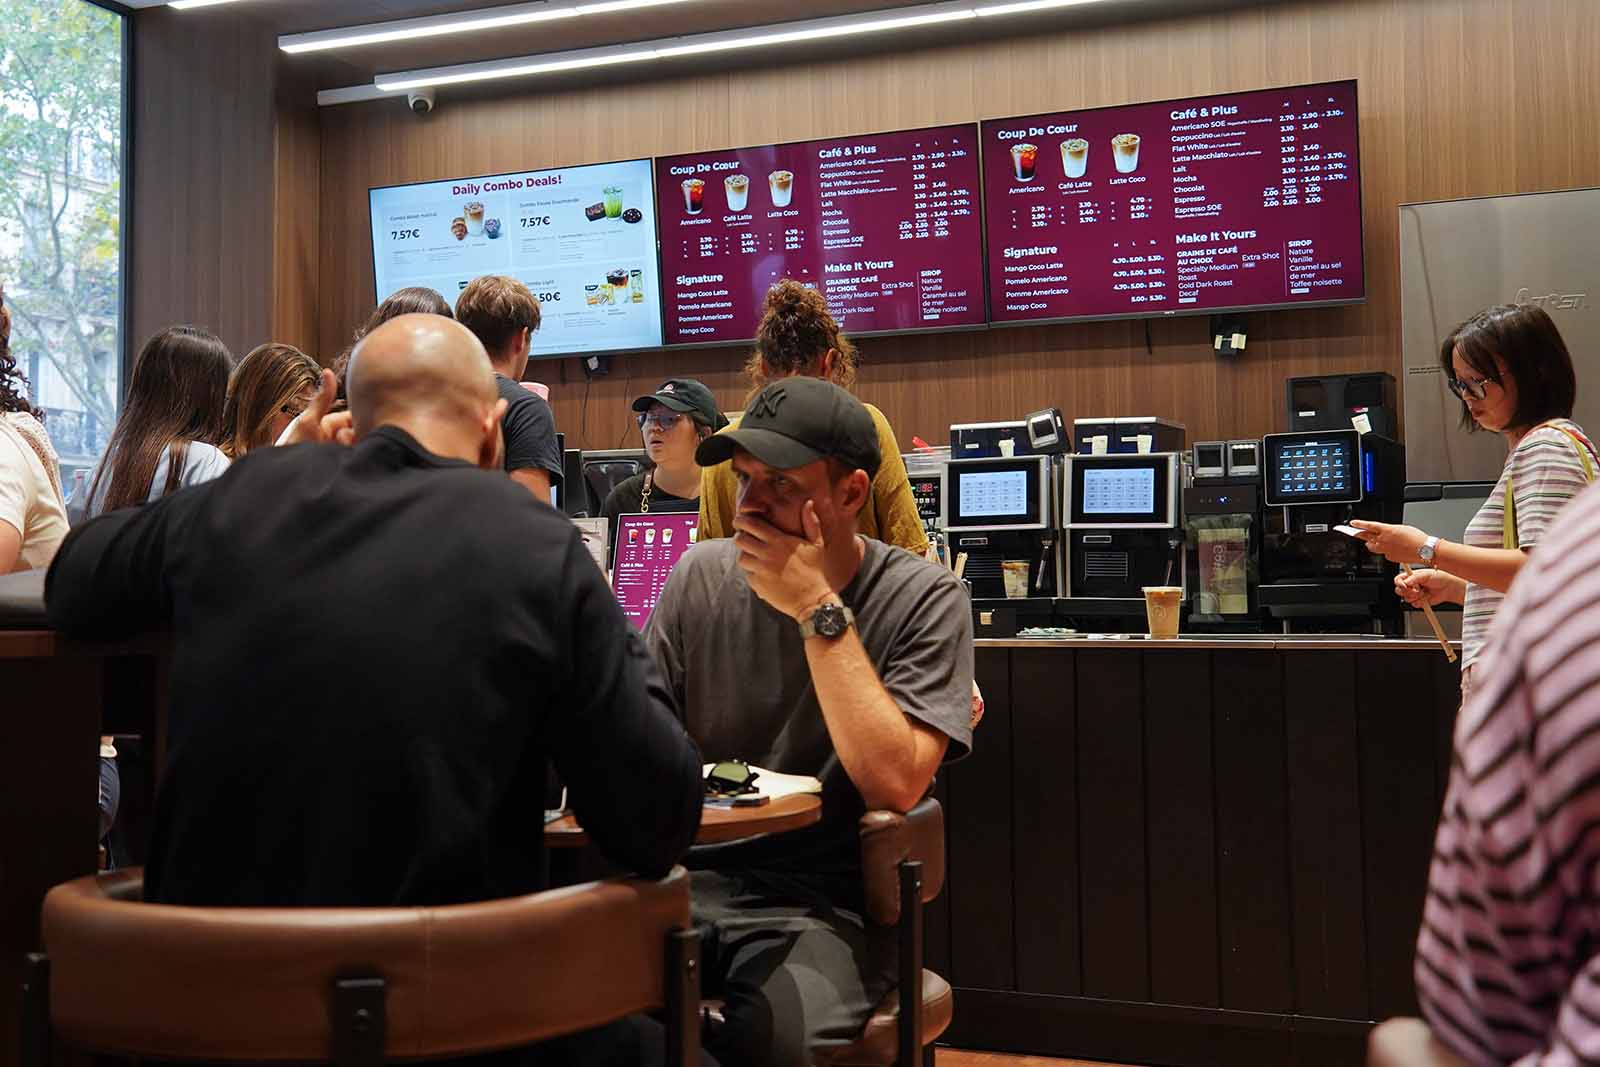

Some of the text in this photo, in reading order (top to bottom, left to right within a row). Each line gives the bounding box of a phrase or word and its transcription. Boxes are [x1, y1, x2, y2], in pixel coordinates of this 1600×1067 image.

[1171, 105, 1238, 120] Café & Plus
[998, 124, 1078, 140] Coup De Cœur
[1171, 123, 1209, 132] Americano
[1172, 132, 1213, 142] Cappuccino
[819, 145, 876, 158] Café & Plus
[1192, 152, 1228, 161] Macchiato
[670, 161, 740, 175] Coup De Cœur
[820, 161, 852, 169] Americano
[820, 170, 856, 179] Cappuccino
[1174, 175, 1197, 183] Mocha
[453, 175, 562, 195] Daily Combo Deals!
[1058, 182, 1074, 190] Café
[1174, 185, 1205, 193] Chocolat
[838, 188, 868, 196] Macchiato
[1009, 186, 1044, 194] Americano
[1175, 196, 1205, 204] Espresso
[1175, 206, 1205, 214] Espresso
[1176, 230, 1256, 244] Make It Yours
[1004, 246, 1057, 259] Signature
[1177, 250, 1204, 258] GRAINS
[1218, 246, 1238, 254] CAFÉ
[1262, 252, 1280, 260] Shot
[825, 263, 851, 273] Make
[864, 261, 893, 270] Yours
[1005, 265, 1027, 273] Mango
[1178, 266, 1208, 274] Specialty
[1290, 263, 1319, 272] Caramel
[676, 274, 723, 286] Signature
[1031, 275, 1067, 283] Americano
[1196, 280, 1212, 288] Dark
[1033, 288, 1068, 296] Americano
[750, 388, 787, 418] NY
